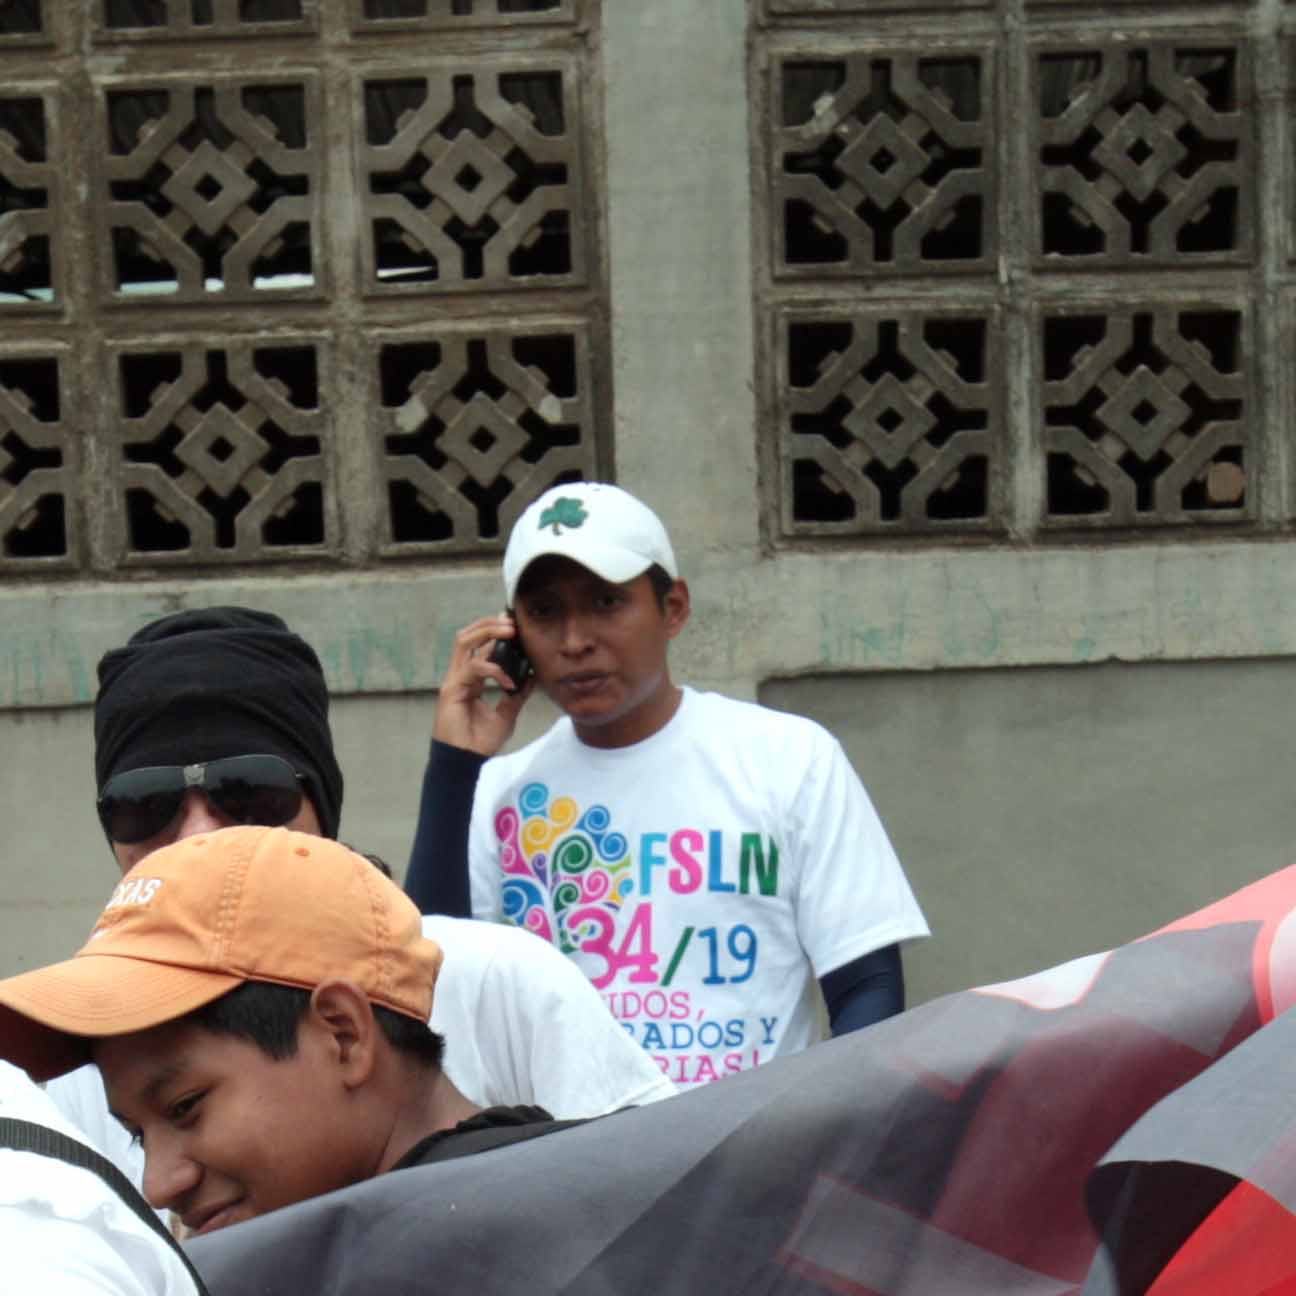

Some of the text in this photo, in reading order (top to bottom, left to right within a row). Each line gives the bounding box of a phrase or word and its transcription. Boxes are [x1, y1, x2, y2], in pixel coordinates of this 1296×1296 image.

[638, 829, 780, 897] FSLN
[105, 878, 161, 911] XAS
[567, 902, 758, 990] 34/19
[759, 1017, 779, 1045] Y
